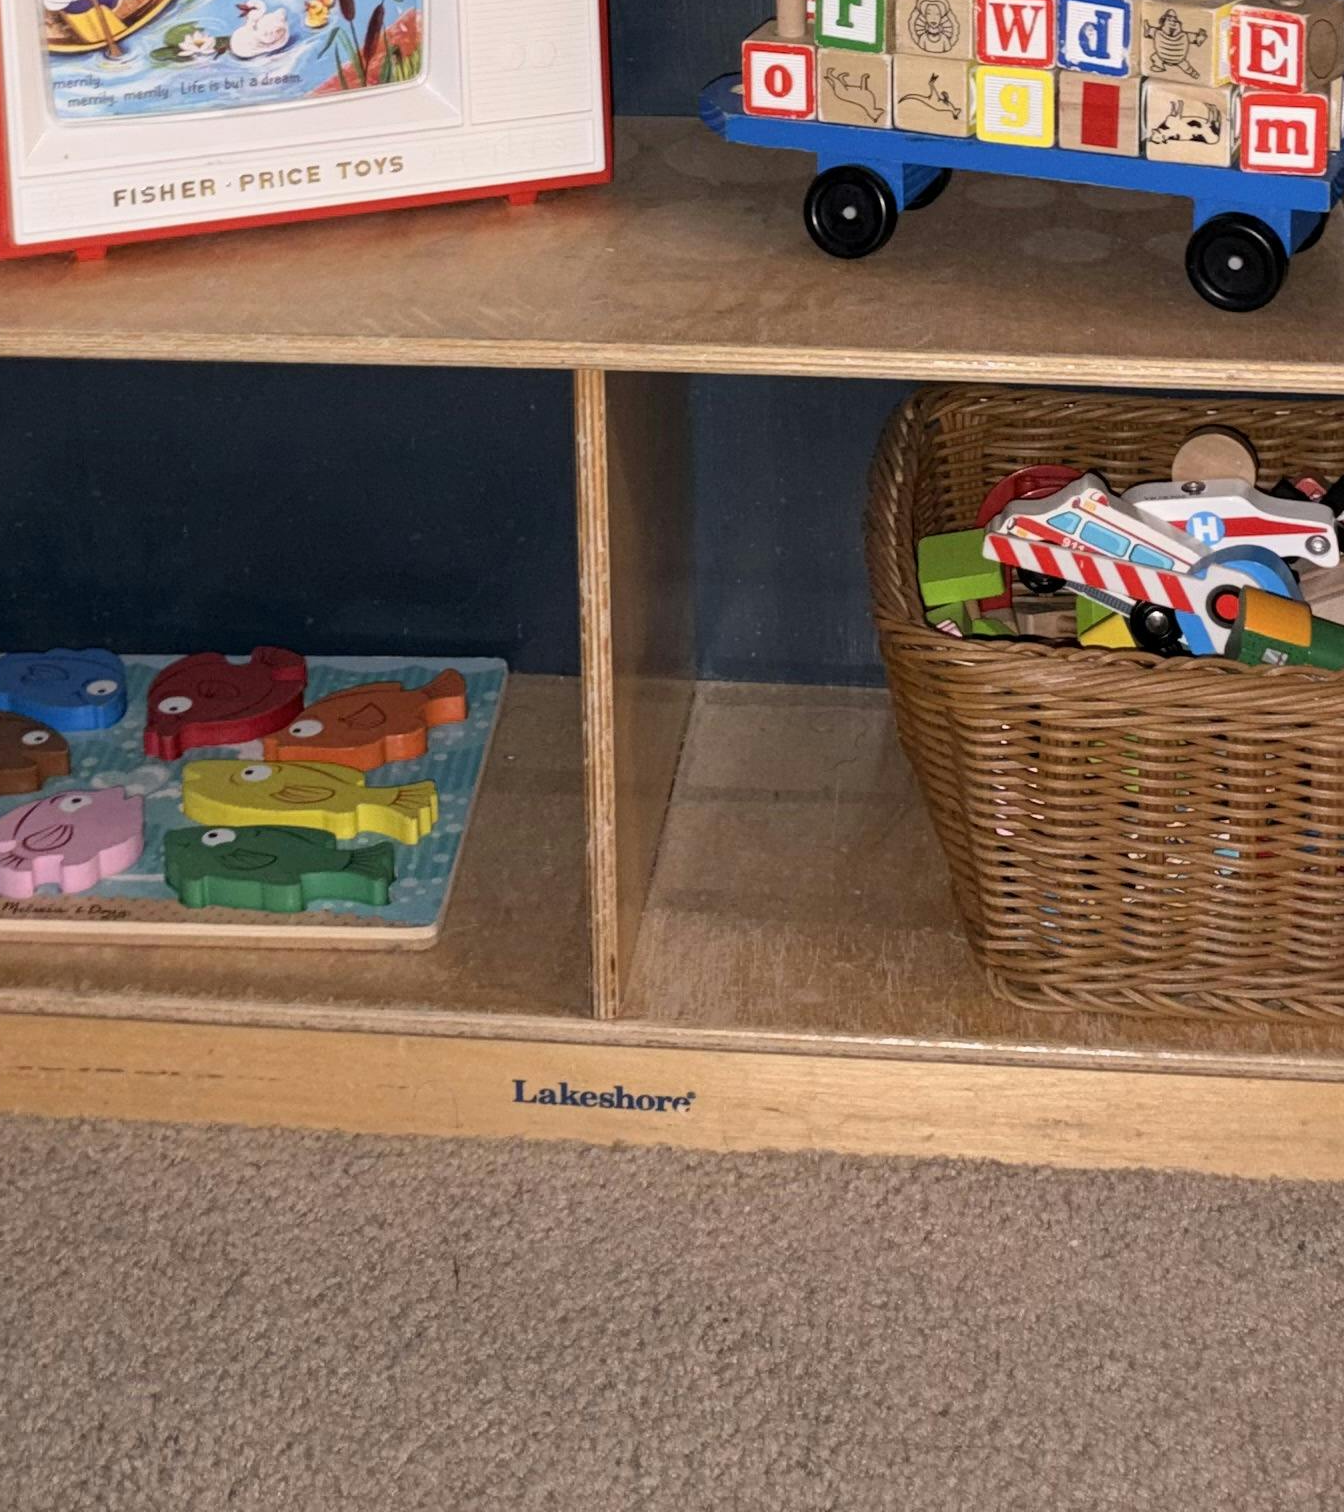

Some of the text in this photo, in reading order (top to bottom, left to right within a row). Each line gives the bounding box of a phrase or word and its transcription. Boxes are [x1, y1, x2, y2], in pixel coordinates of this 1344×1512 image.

[989, 2, 1044, 54] W
[1078, 10, 1112, 59] d
[1246, 22, 1289, 73] E
[180, 81, 205, 95] Life
[209, 80, 219, 92] is
[224, 77, 245, 90] but
[249, 78, 257, 87] a
[999, 84, 1031, 128] g
[1255, 118, 1309, 156] m
[113, 155, 405, 208] FISHER PRICE TOYS
[1192, 516, 1219, 542] H
[512, 1079, 692, 1112] Lakeshore
